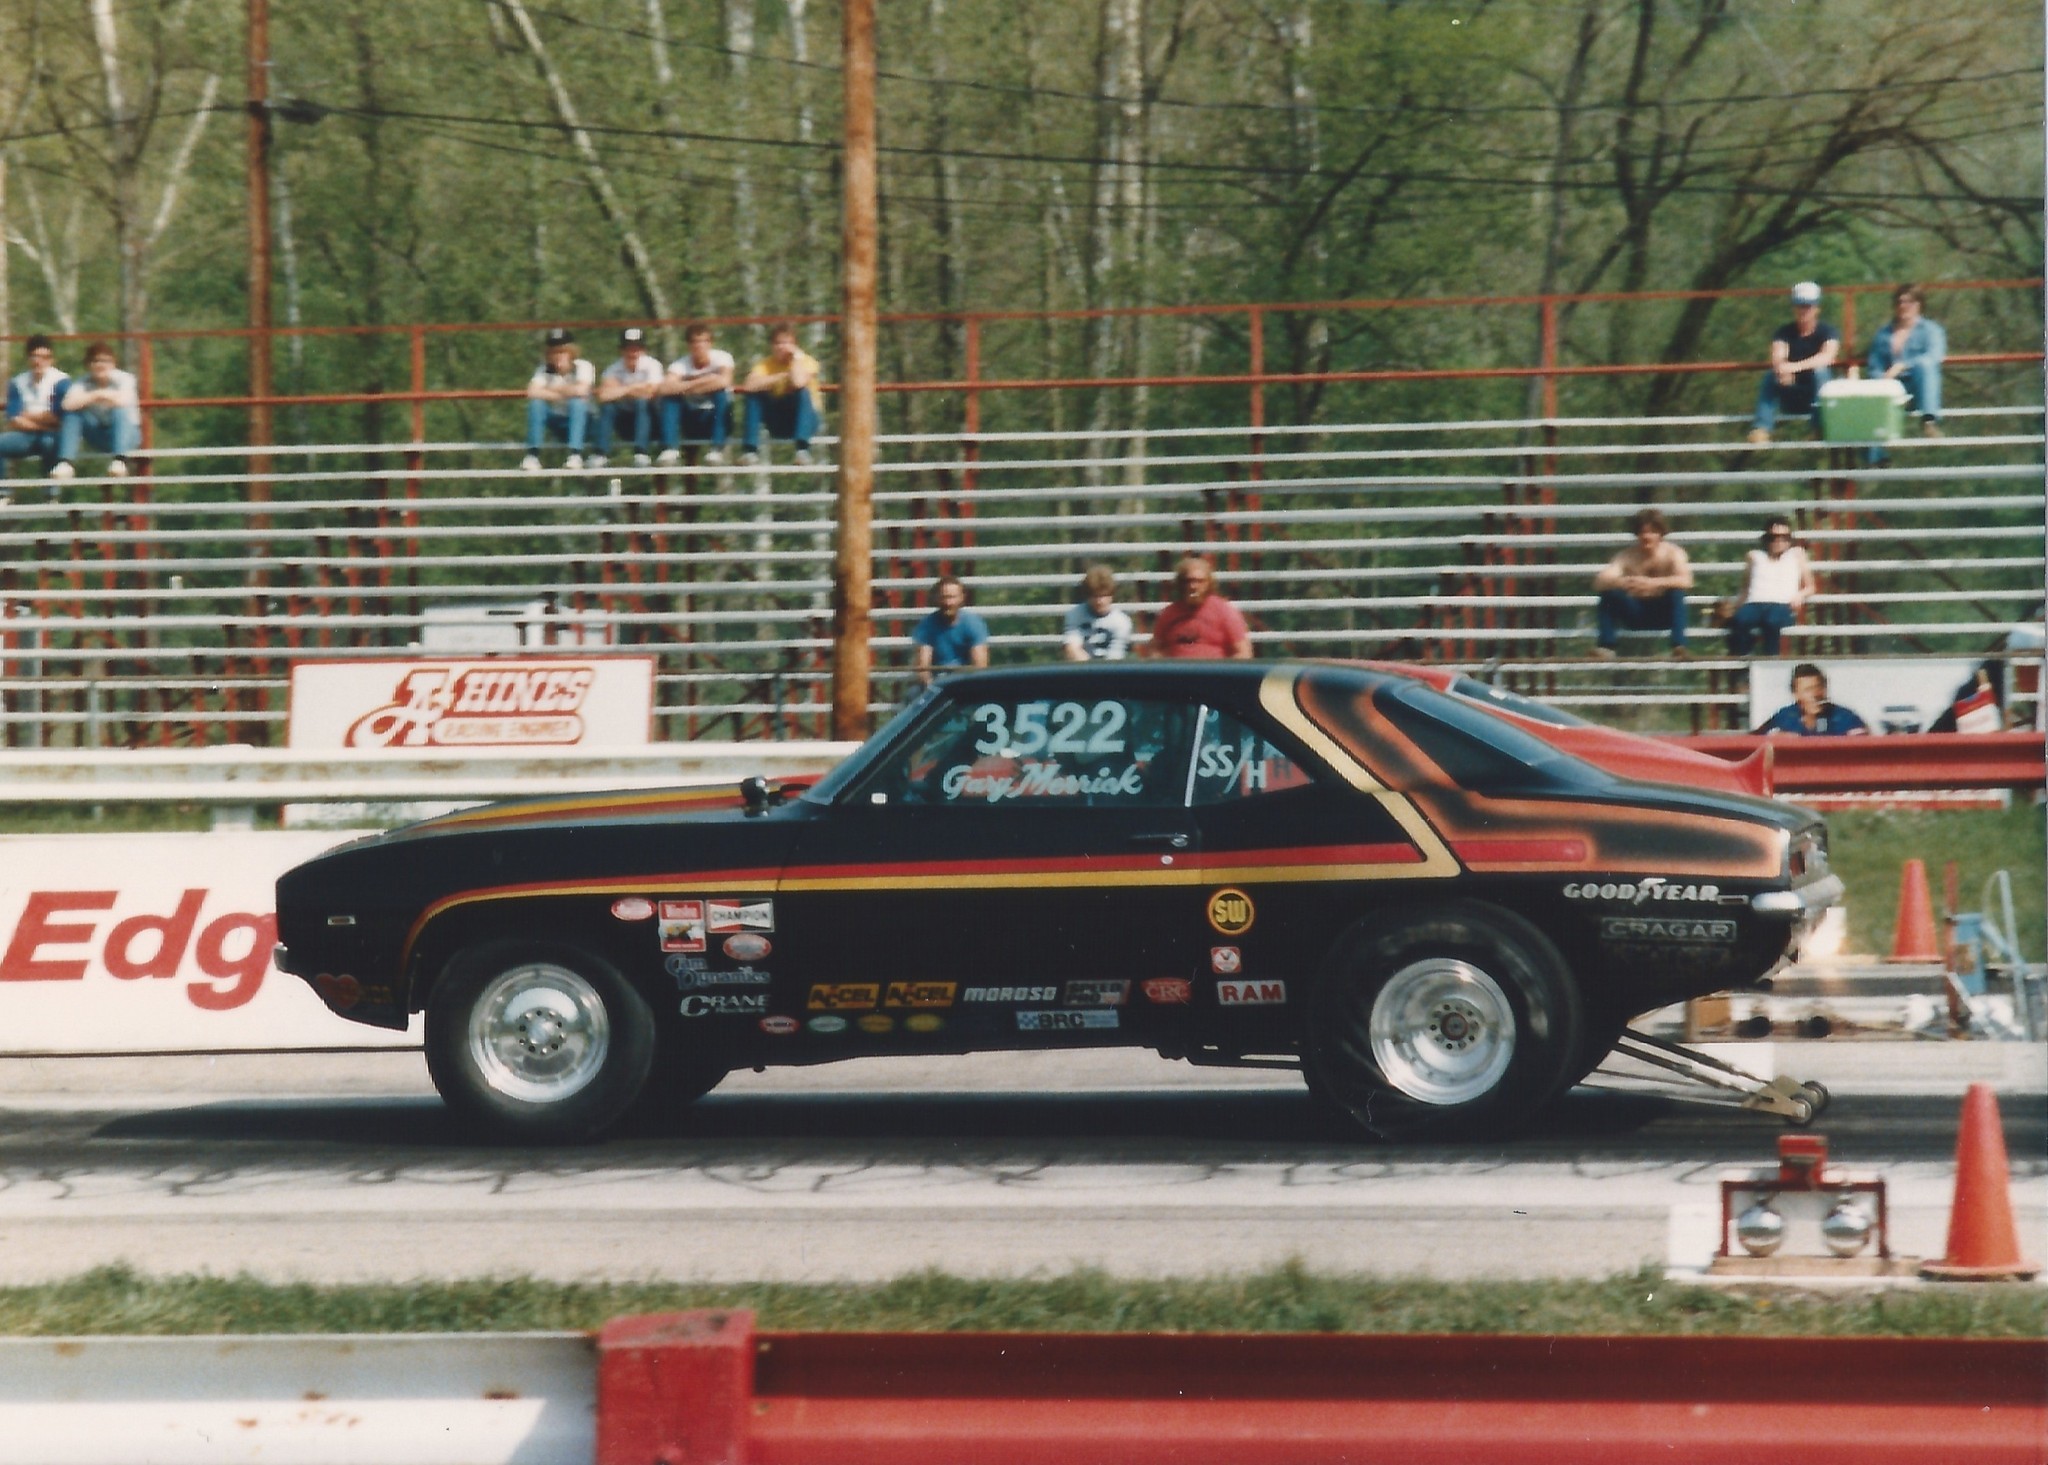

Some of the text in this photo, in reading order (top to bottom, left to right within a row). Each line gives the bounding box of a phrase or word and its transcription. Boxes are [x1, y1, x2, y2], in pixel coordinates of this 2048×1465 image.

[454, 667, 594, 713] HINES
[974, 700, 1128, 755] 3522
[943, 761, 1143, 803] Gary Merrick
[712, 908, 769, 921] CHAMPION
[1607, 920, 1731, 938] CRAGAR
[963, 986, 1057, 1002] MOROSO
[1145, 983, 1190, 999] CRC
[1222, 984, 1282, 1003] RAM
[680, 994, 771, 1017] CRANE
[1038, 1012, 1084, 1029] BRC
